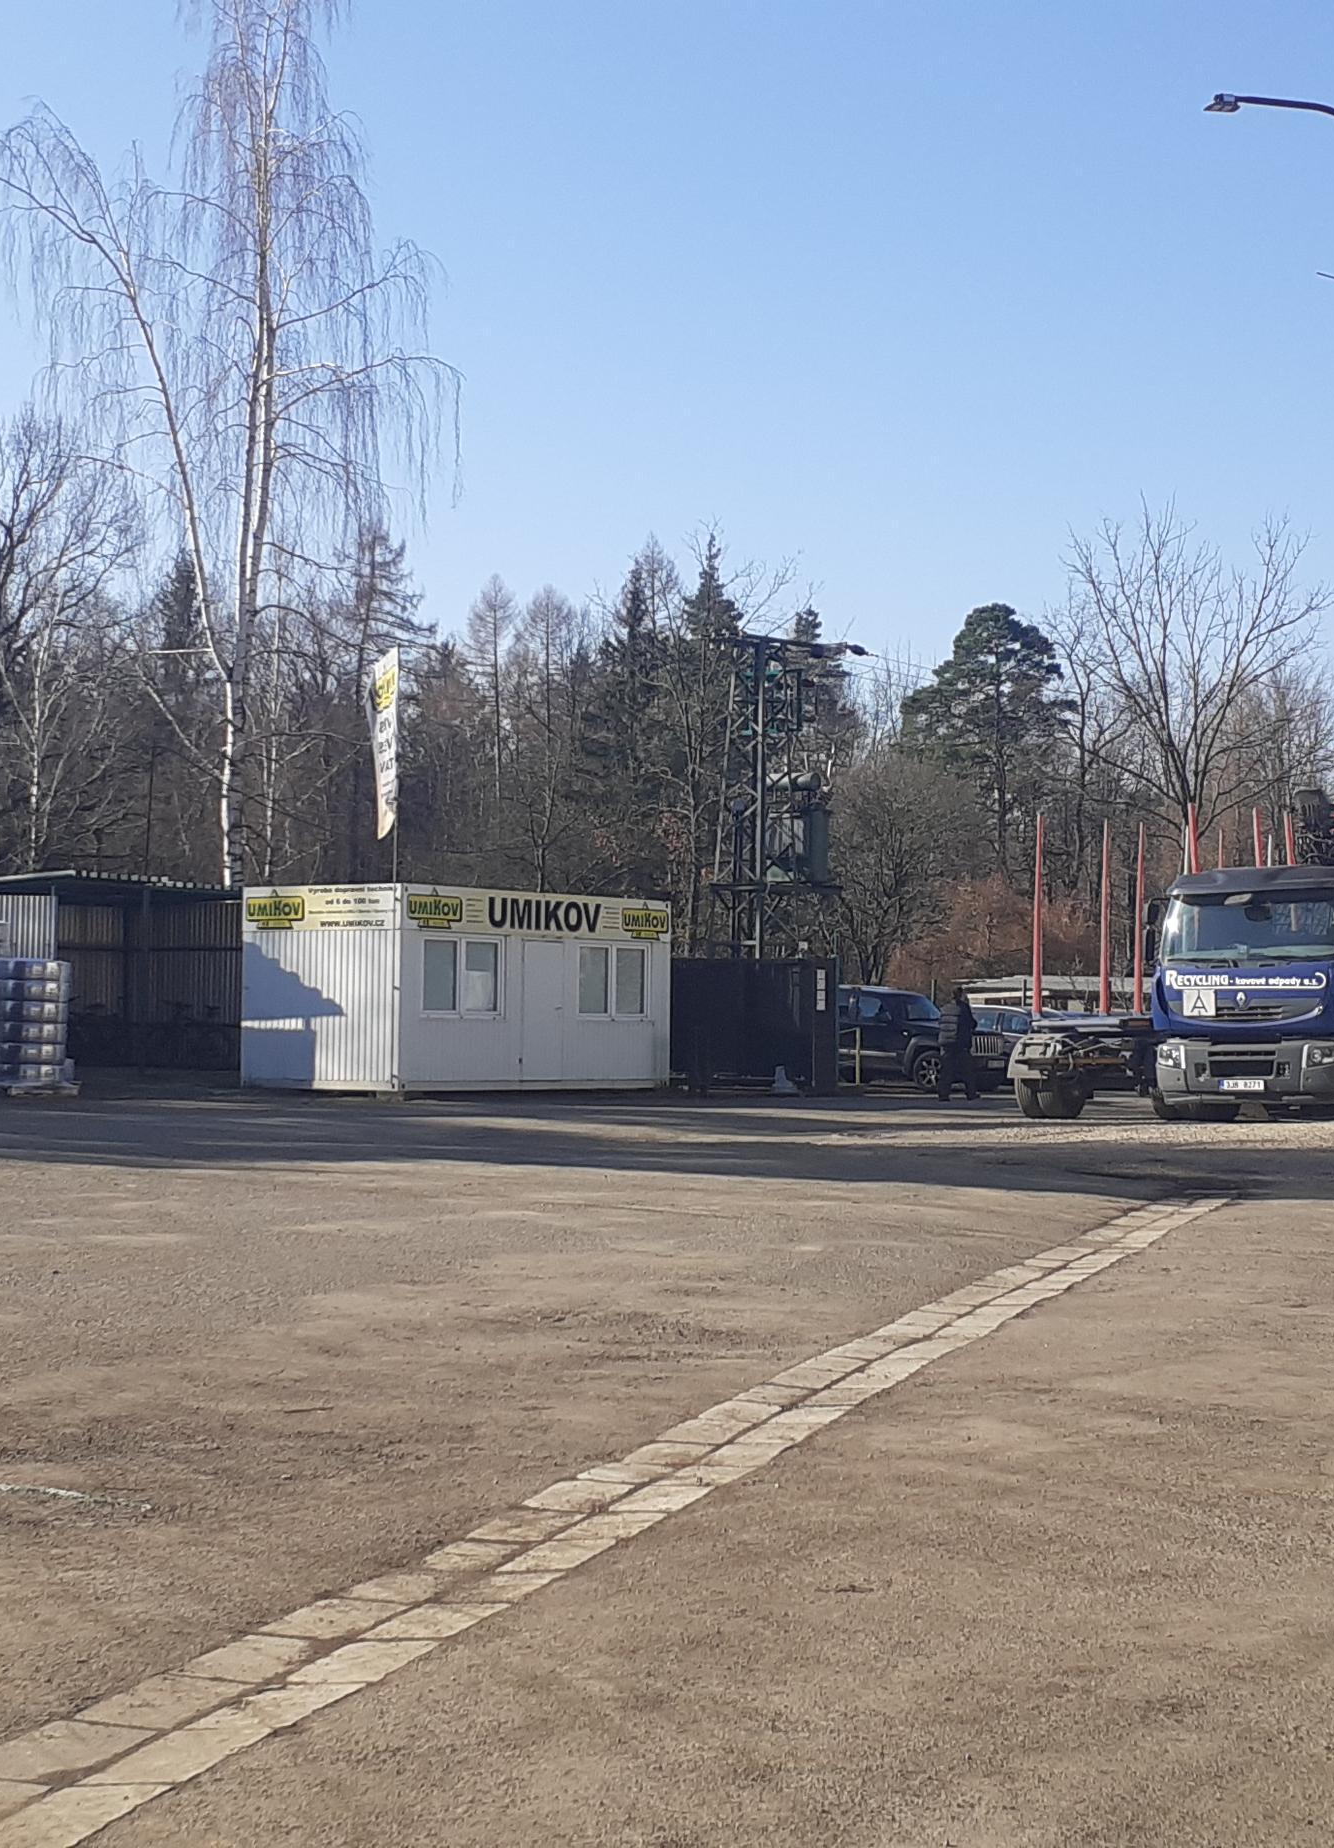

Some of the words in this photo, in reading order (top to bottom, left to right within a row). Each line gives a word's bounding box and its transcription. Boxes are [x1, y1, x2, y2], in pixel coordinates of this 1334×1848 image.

[248, 900, 300, 917] UMIKOV
[410, 899, 459, 917] UMIKOV
[488, 896, 602, 933] UMIKOV
[624, 912, 666, 929] UMIKOV
[1190, 991, 1209, 1013] A
